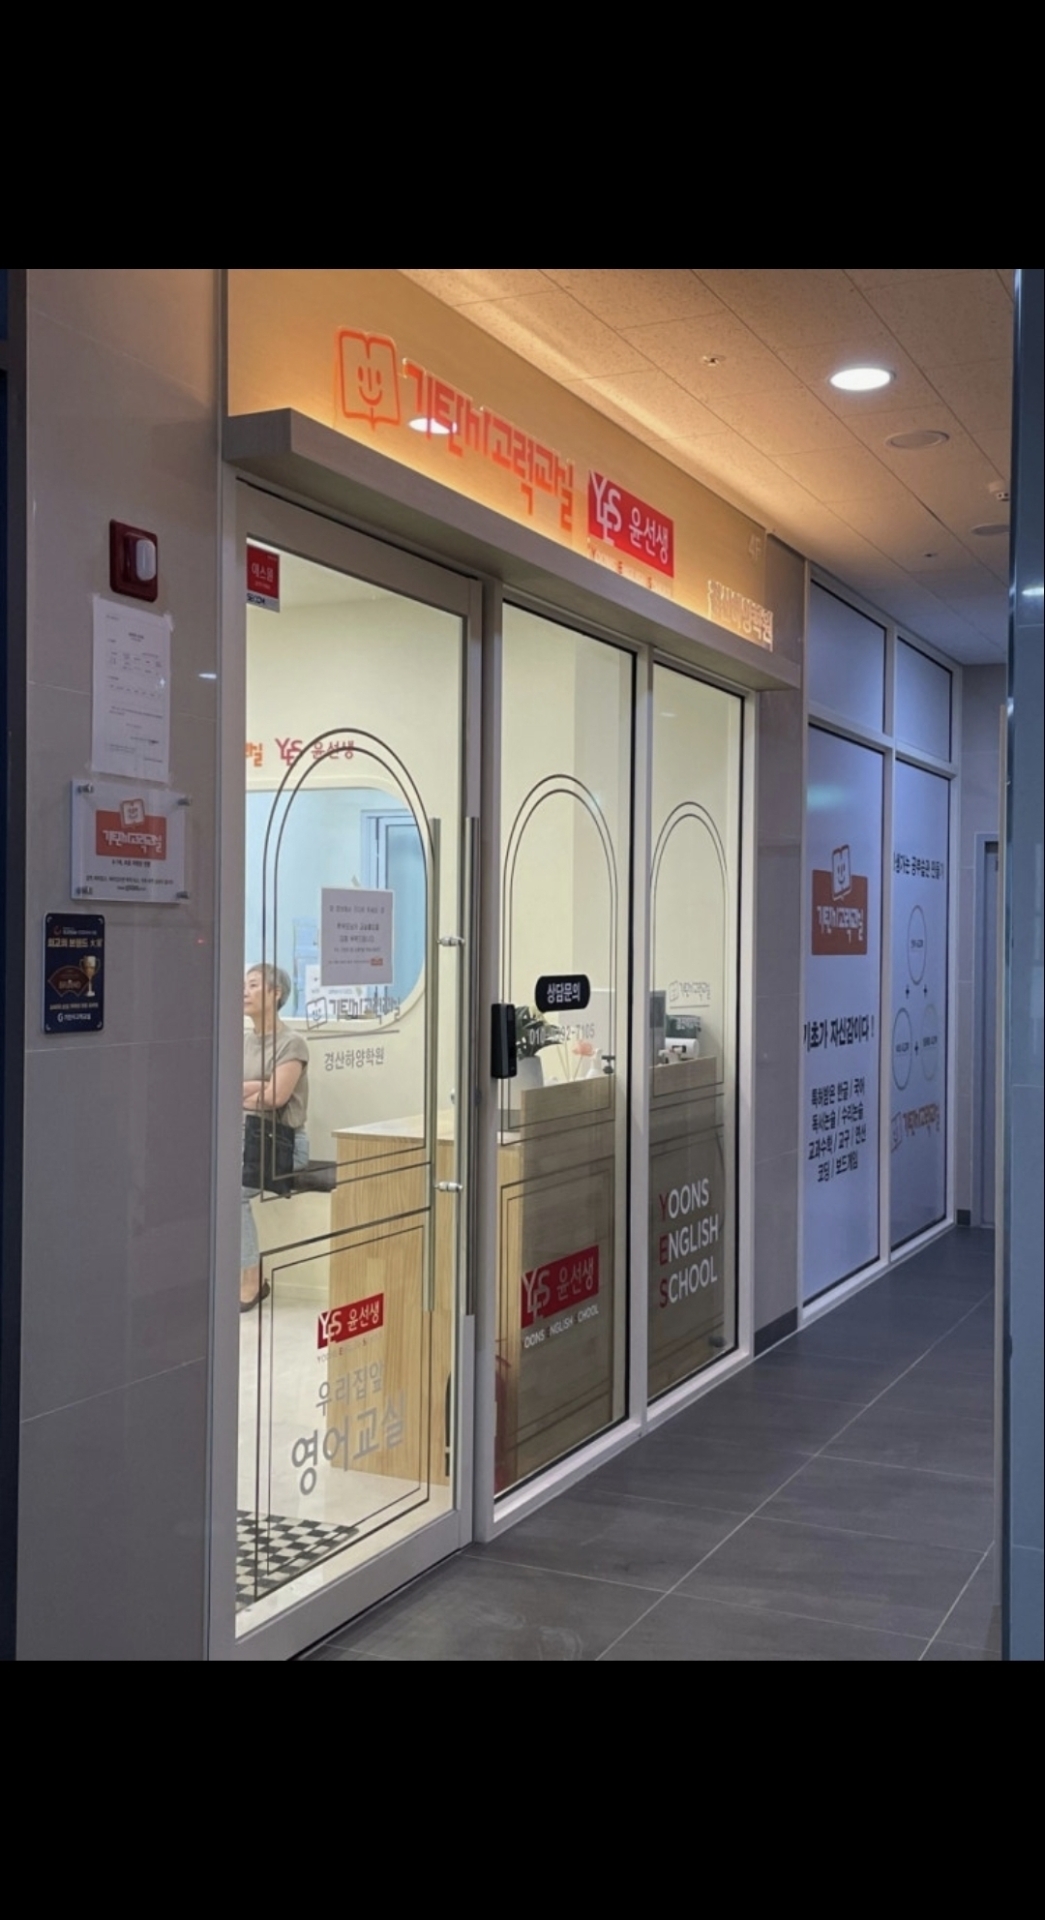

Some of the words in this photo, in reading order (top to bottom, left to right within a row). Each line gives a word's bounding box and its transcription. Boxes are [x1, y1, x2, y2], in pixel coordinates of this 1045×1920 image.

[403, 359, 574, 533] 기탄사고력교실
[629, 507, 669, 564] 윤선생
[311, 741, 354, 760] 윤선생
[547, 982, 581, 1004] 상담문의
[324, 1047, 385, 1072] 경산하양학원
[659, 1178, 710, 1222] YOONS
[659, 1213, 719, 1266] ENGLISH
[556, 1256, 595, 1302] 윤선생
[659, 1255, 718, 1309] SCHOOL
[347, 1300, 381, 1333] 윤선생
[316, 1360, 385, 1417] 우리집앞
[291, 1389, 408, 1496] 영어교실
